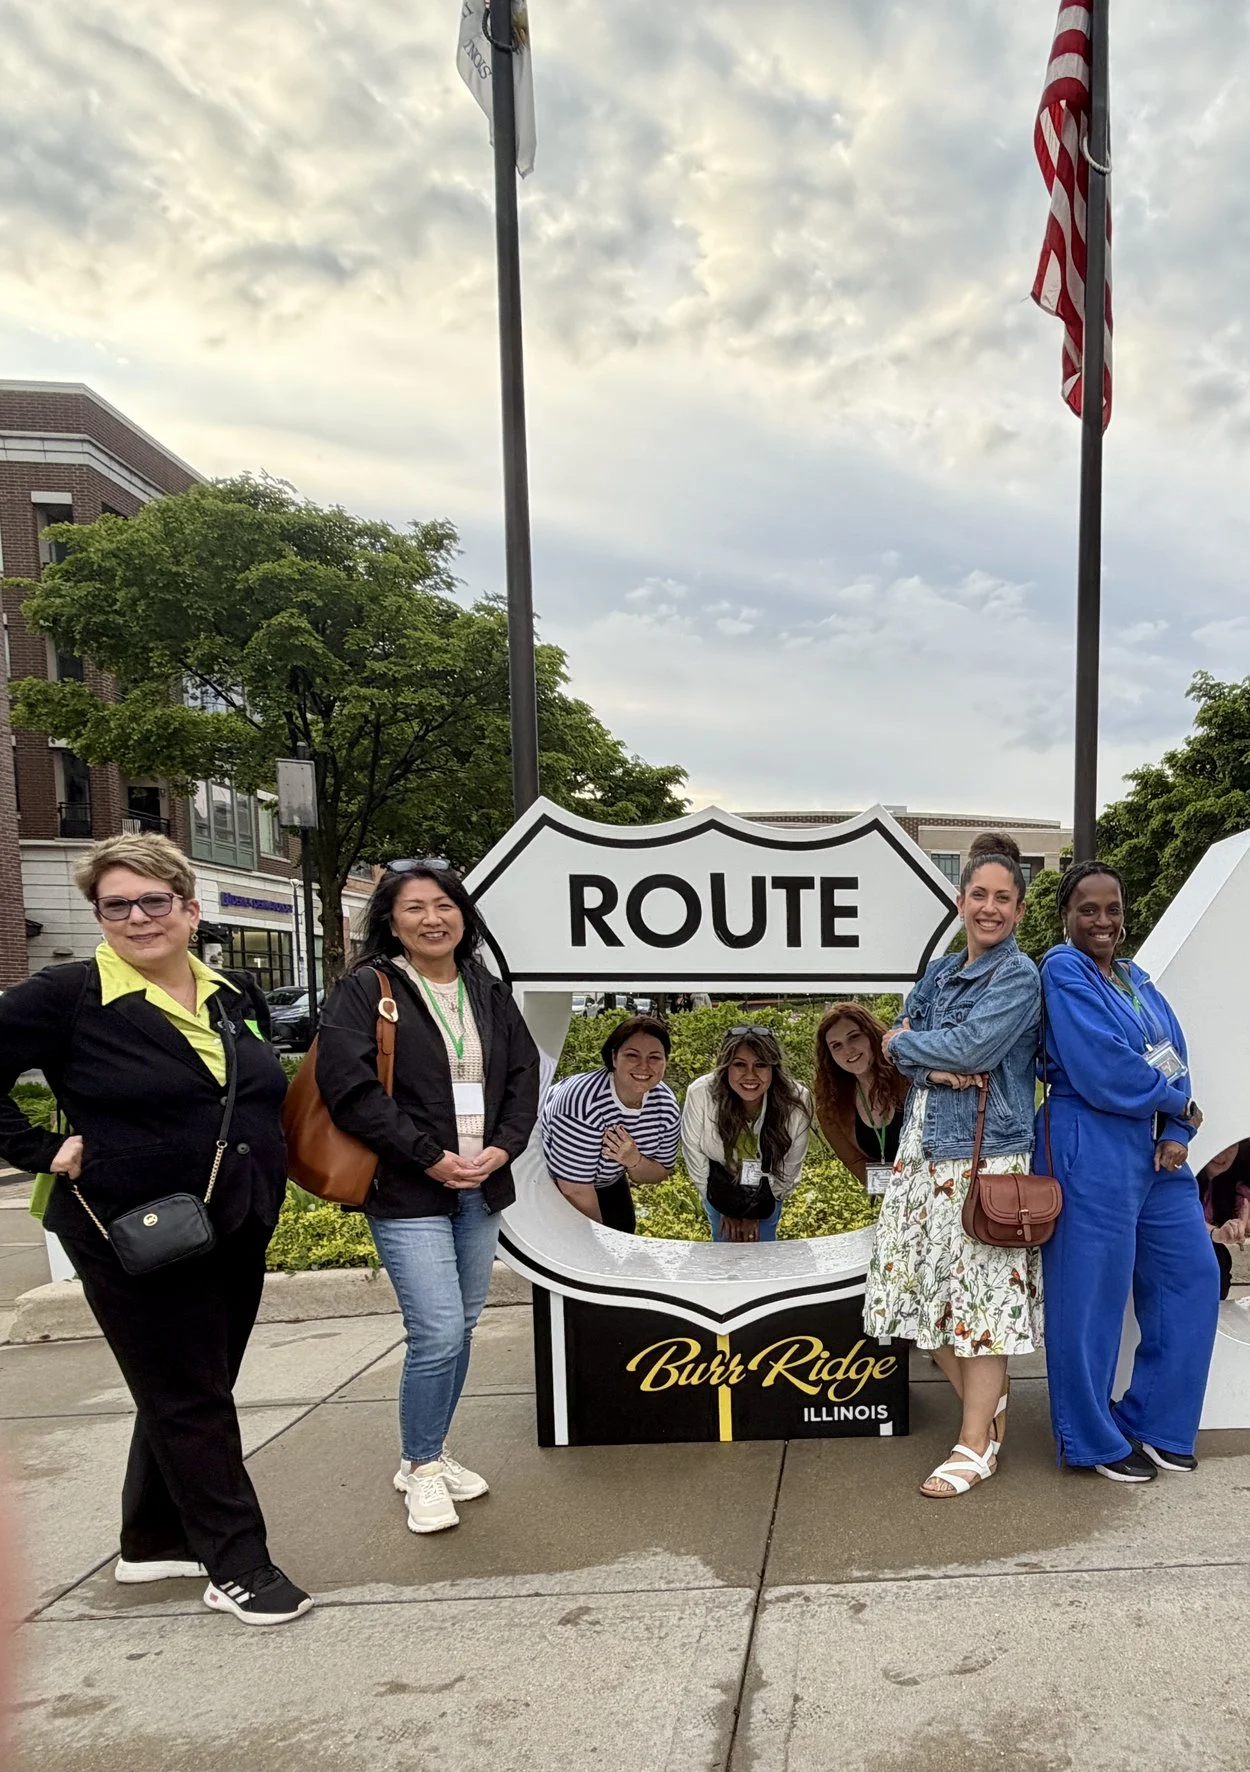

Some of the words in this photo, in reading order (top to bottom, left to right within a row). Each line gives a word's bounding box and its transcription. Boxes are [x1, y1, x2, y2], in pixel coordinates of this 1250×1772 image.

[569, 872, 861, 949] ROUTE
[626, 1337, 746, 1392] Burr
[747, 1335, 898, 1402] Ridge
[803, 1404, 888, 1422] ILLINOIS
